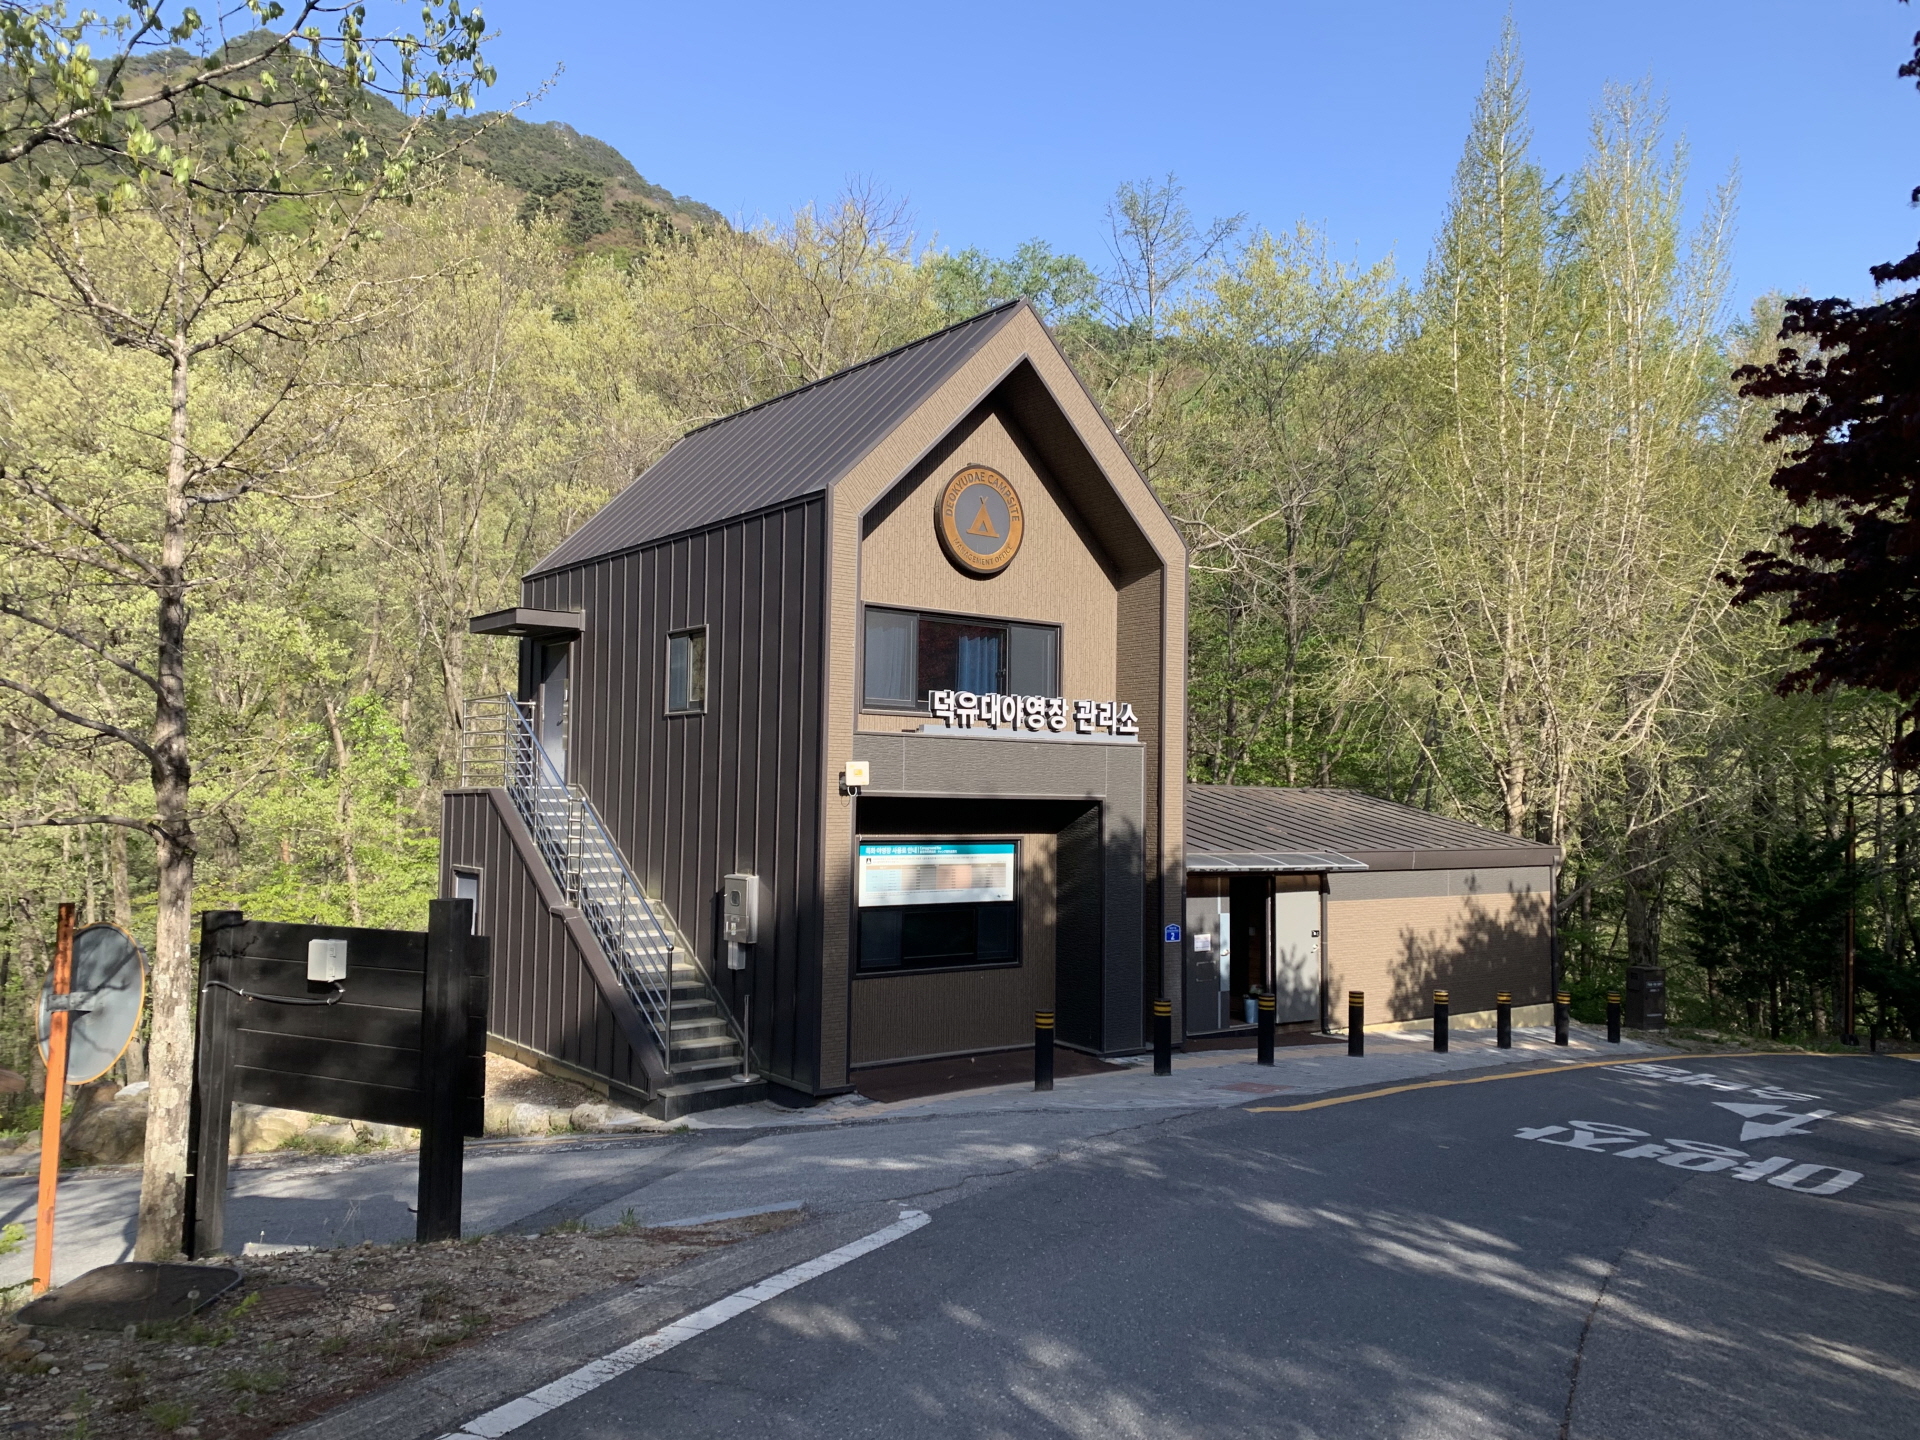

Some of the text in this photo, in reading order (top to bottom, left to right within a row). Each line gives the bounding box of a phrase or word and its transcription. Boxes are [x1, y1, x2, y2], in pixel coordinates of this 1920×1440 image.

[945, 471, 1020, 522] DEOKYUDAE CAMPSITE
[953, 537, 1014, 565] MANAGEMENT OFFICE
[930, 690, 1140, 734] 덕유대야영장 관리소
[1170, 932, 1175, 940] 2
[1513, 1119, 1865, 1195] 야영장
